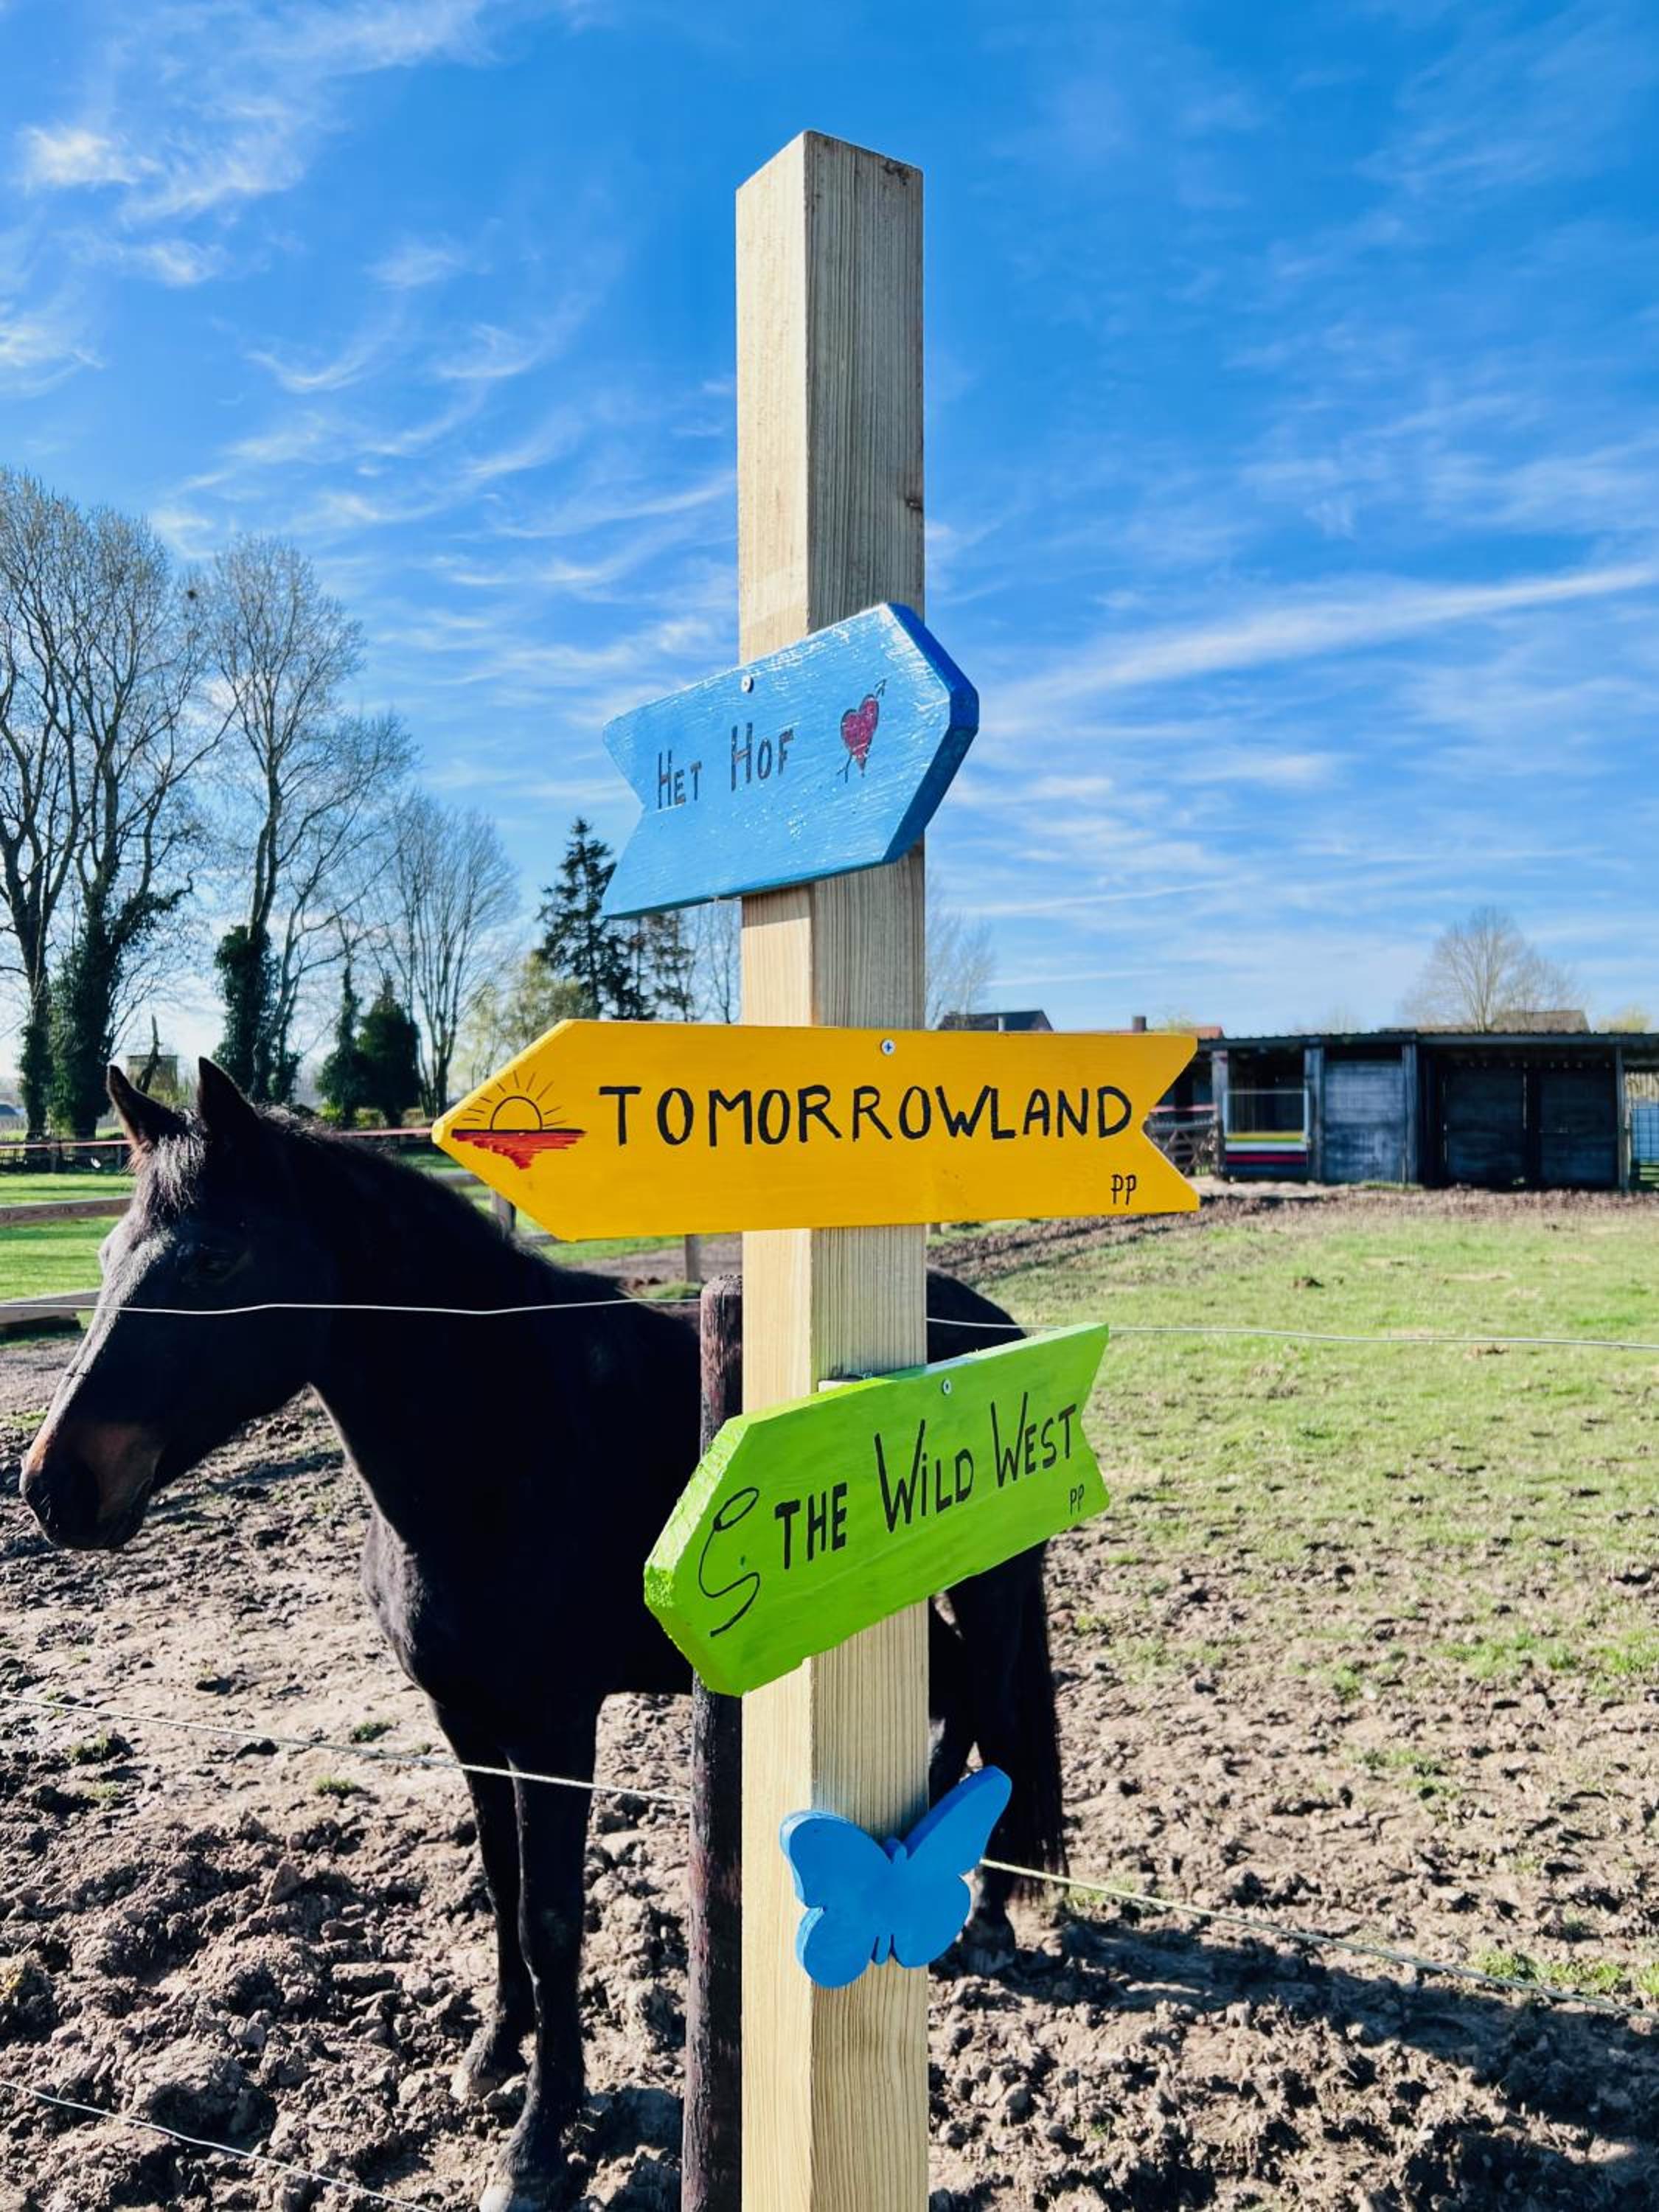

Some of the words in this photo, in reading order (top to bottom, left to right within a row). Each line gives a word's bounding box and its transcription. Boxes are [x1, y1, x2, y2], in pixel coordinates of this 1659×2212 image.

[598, 1085, 1133, 1148] TOMORROWLAND
[774, 1482, 847, 1570] THE
[990, 1391, 1077, 1488] WEST
